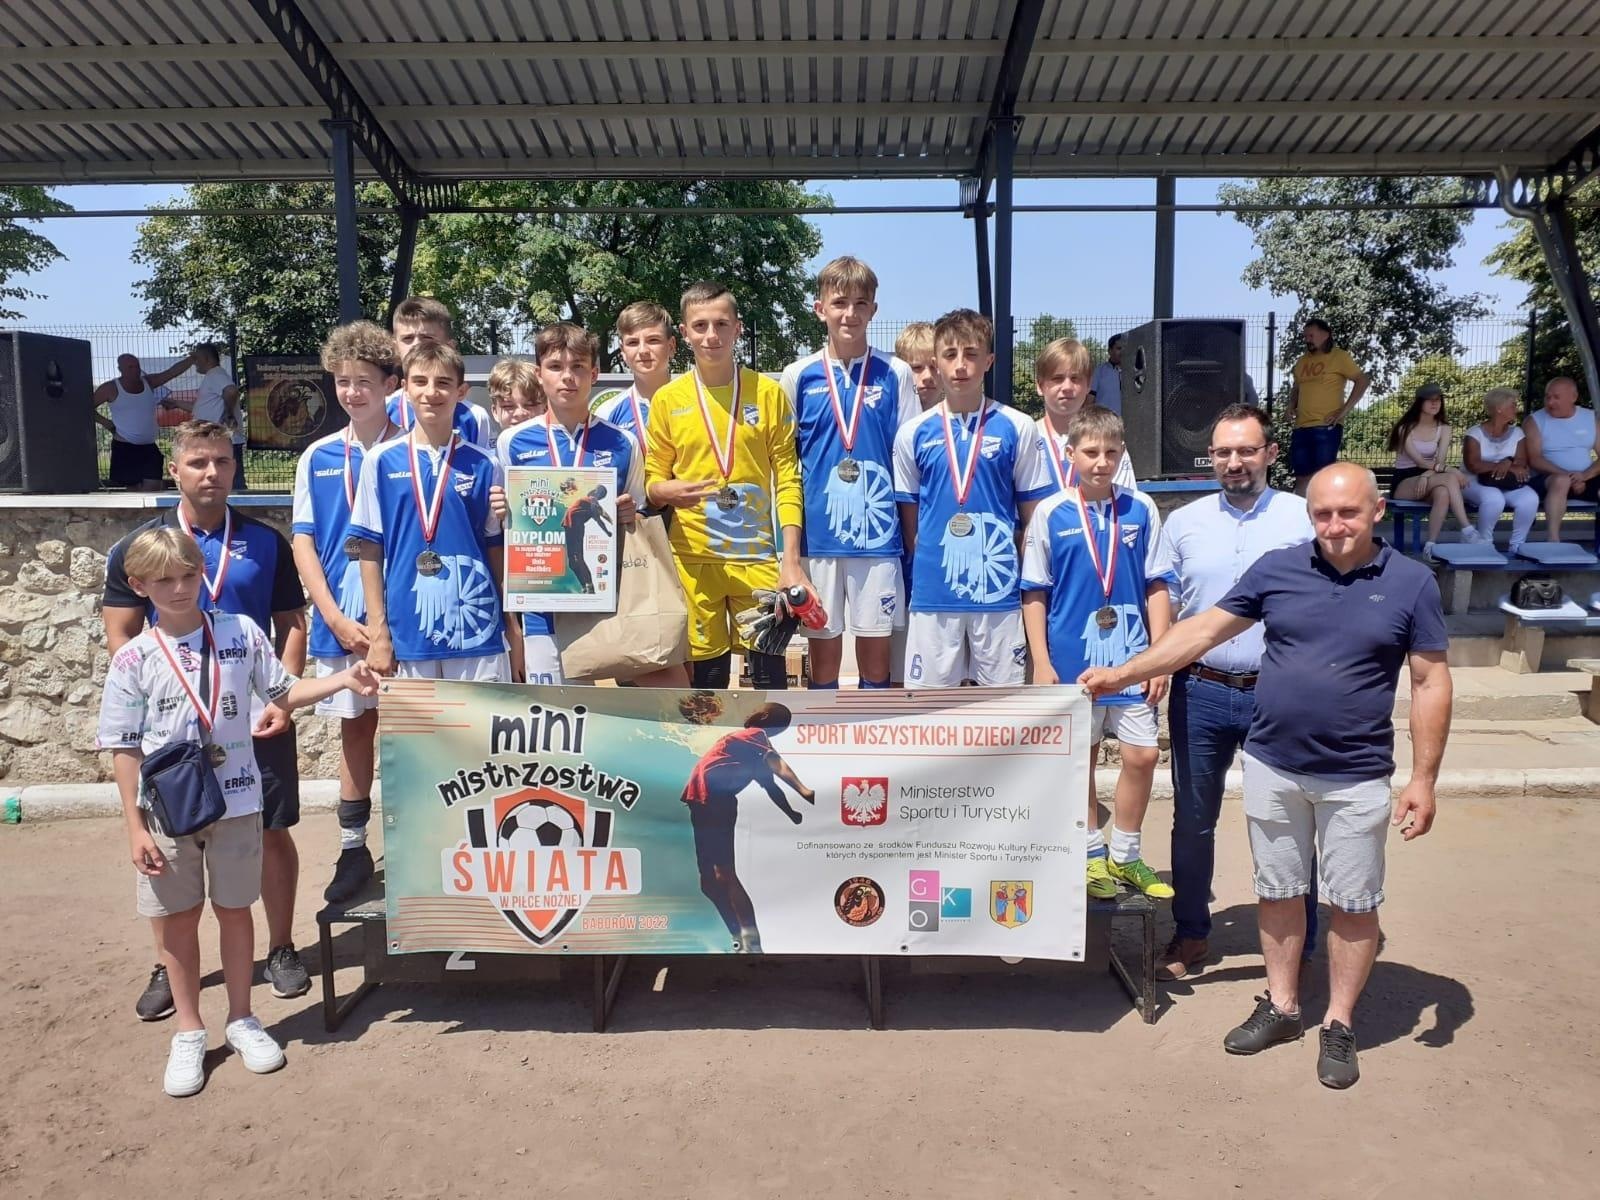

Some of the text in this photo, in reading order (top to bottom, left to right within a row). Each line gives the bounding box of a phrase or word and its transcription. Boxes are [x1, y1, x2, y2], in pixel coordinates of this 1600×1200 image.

[387, 471, 412, 479] salle
[512, 530, 566, 545] DYPLOM
[909, 653, 923, 680] 6
[490, 704, 588, 755] mini
[796, 723, 1063, 747] SPORT WSZYSTKICH DZIECI 2022
[437, 761, 641, 809] mistrzostwa
[900, 785, 995, 799] Ministerstwo
[900, 805, 949, 822] Sportu
[961, 804, 1030, 823] Turystyki
[796, 841, 861, 850] Dofinansowano
[878, 840, 914, 849] środków
[915, 840, 957, 849] Funduszu
[959, 841, 996, 852] Rozwoju
[998, 842, 1028, 853] Kultury
[826, 851, 857, 860] których
[858, 851, 915, 861] dysponentem
[917, 851, 932, 860] jest
[934, 850, 967, 860] Minister
[969, 852, 998, 862] Sportu
[1005, 853, 1042, 863] Turystyki
[452, 842, 628, 893] ŚWIATA
[499, 892, 582, 908] W PIŁCE NOŻNEJ
[582, 914, 669, 929] BABORÓW 2022
